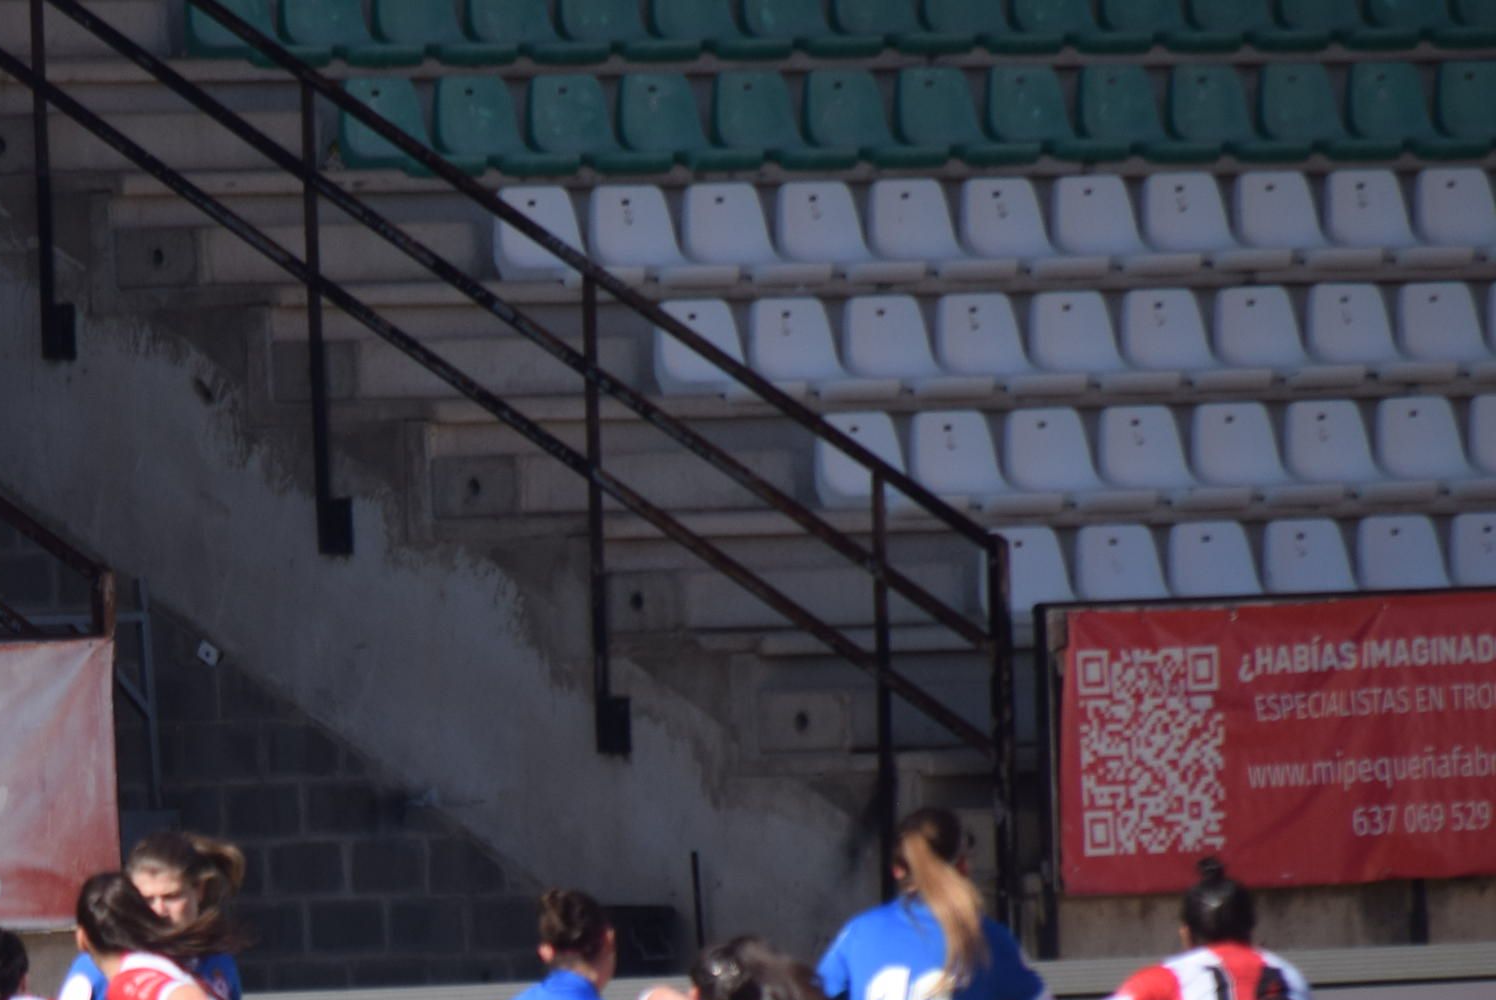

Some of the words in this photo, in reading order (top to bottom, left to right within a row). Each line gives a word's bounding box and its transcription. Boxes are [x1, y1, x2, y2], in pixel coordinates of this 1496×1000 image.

[1239, 635, 1357, 682] ¿HABÍAS
[1362, 635, 1496, 669] IMAGINAD
[1255, 687, 1411, 722] ESPECIALISTAS
[1416, 684, 1445, 713] EN
[1450, 681, 1496, 711] TRO
[1353, 804, 1397, 836] 637
[1404, 802, 1445, 833] 069
[1451, 801, 1492, 832] 529
